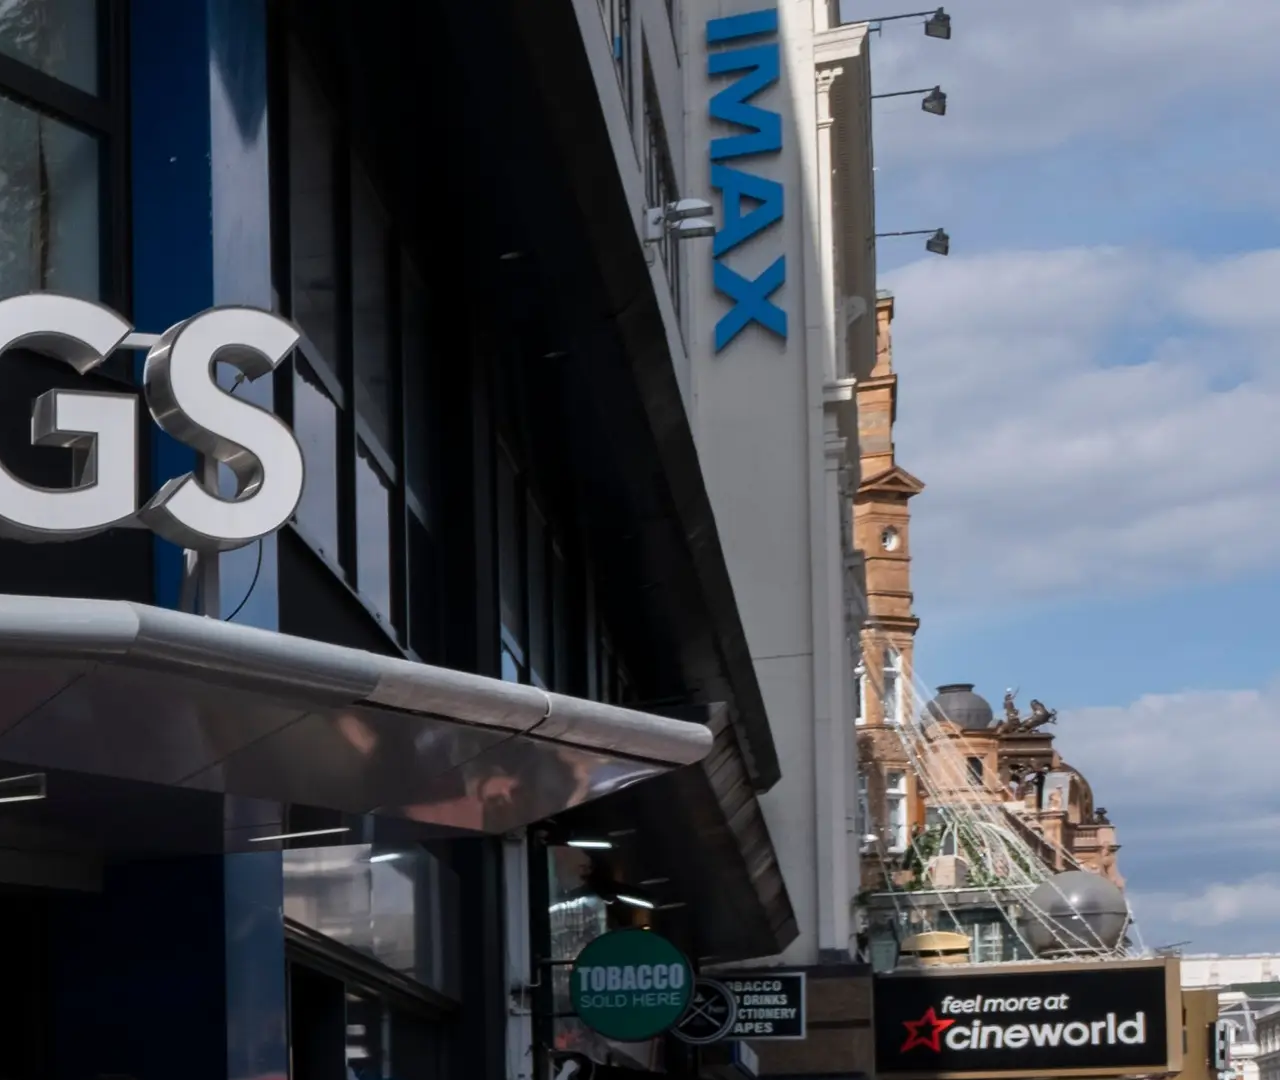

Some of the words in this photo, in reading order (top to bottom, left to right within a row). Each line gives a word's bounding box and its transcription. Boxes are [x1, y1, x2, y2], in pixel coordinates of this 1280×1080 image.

[706, 8, 787, 352] IMAX
[577, 963, 684, 992] TOBACCO
[581, 994, 627, 1008] SOLD
[632, 992, 682, 1007] HERE
[743, 994, 787, 1005] DRINKS
[941, 994, 981, 1015] feel
[983, 998, 1040, 1013] more
[1044, 994, 1069, 1011] at
[738, 1008, 797, 1019] CTIONERY
[733, 1022, 774, 1033] APES
[945, 1012, 1146, 1051] cineworld
